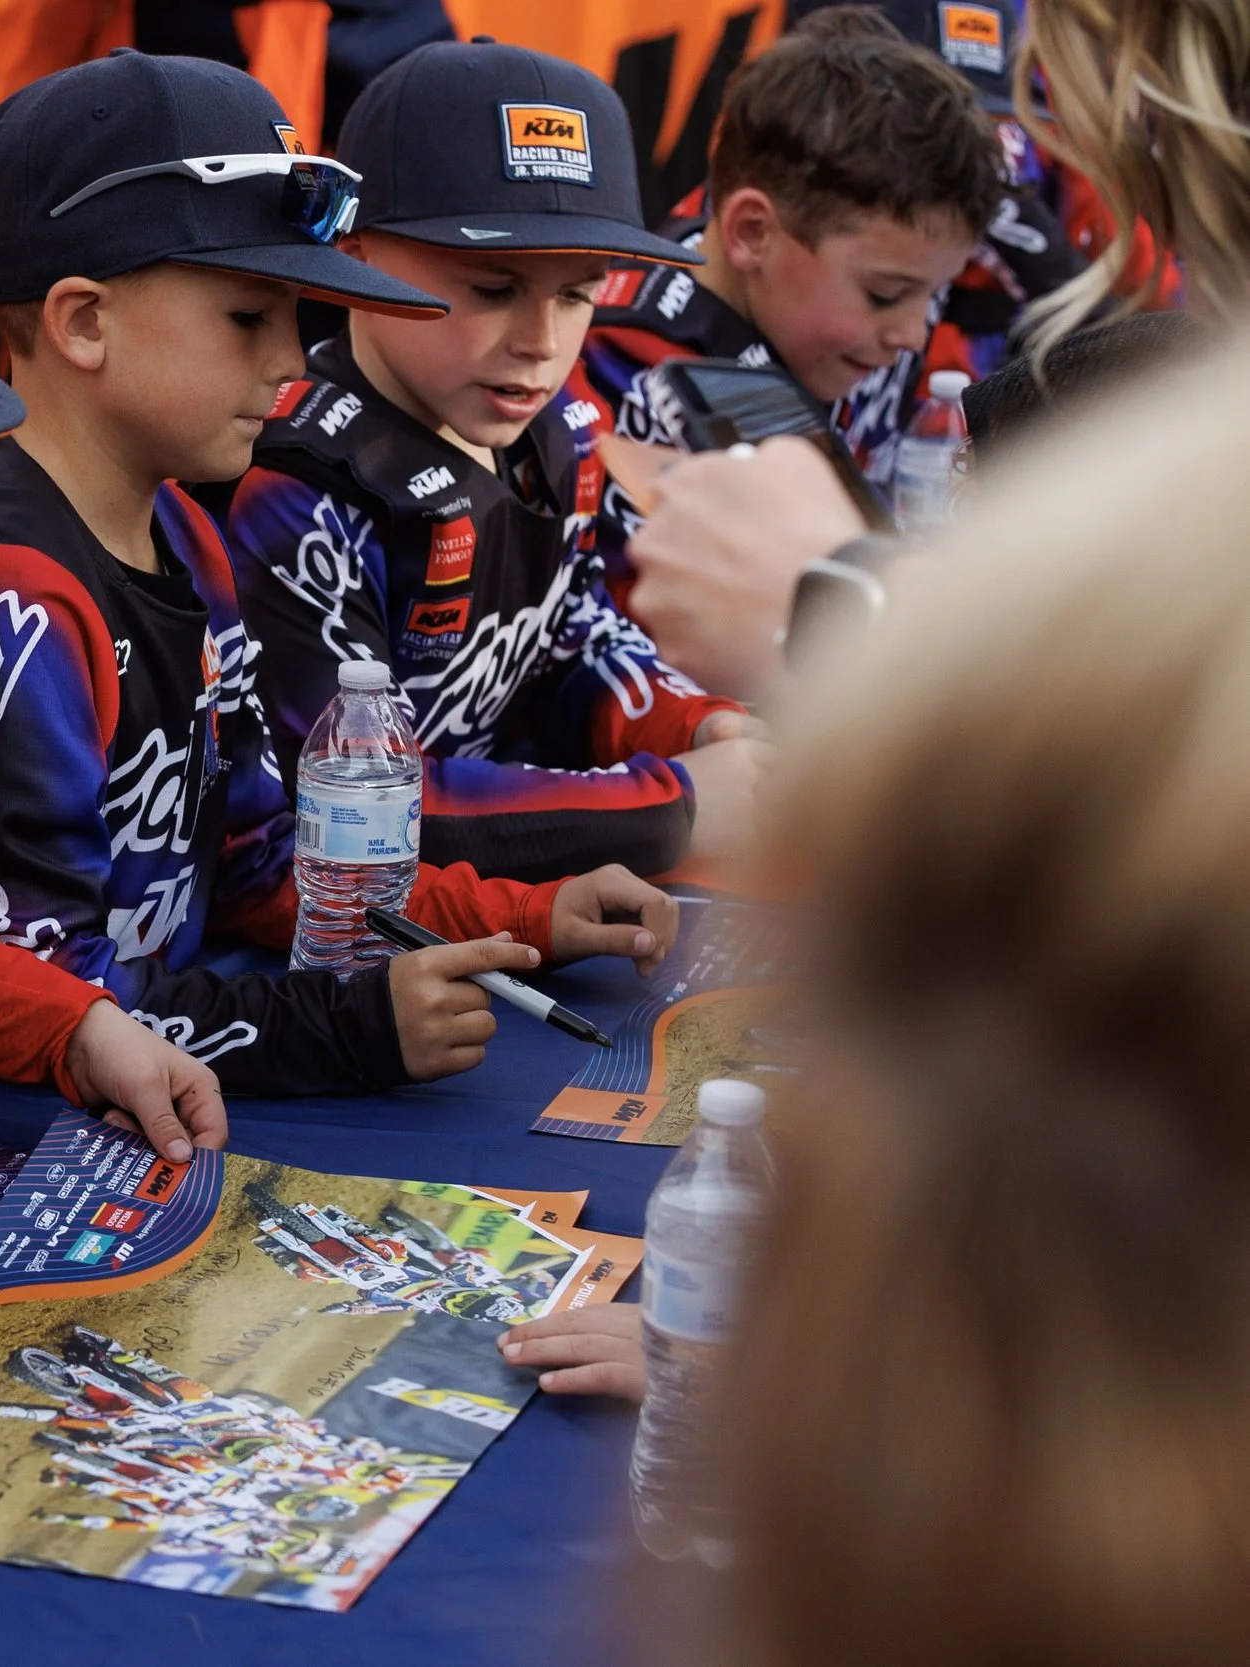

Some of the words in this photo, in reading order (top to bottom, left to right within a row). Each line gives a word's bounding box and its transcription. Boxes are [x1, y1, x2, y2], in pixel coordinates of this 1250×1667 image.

[523, 117, 575, 139] KTM
[512, 147, 558, 161] RACING
[559, 149, 587, 165] TEAM
[514, 165, 530, 178] JR.
[532, 165, 590, 182] SUPERCROSS
[657, 270, 696, 321] KTM
[318, 392, 363, 437] KTM
[562, 400, 601, 431] KTM
[407, 466, 456, 500] KTM
[436, 534, 472, 551] WELLS
[435, 549, 471, 565] FARGO
[612, 1098, 648, 1122] KTM
[81, 1135, 105, 1166] nihilo
[105, 1155, 134, 1191] SUPERCROSS
[132, 1151, 157, 1181] RACING
[58, 1175, 79, 1199] OGIO
[120, 1178, 138, 1197] TEAM
[147, 1164, 175, 1198] KTM
[37, 1211, 57, 1229] 100%
[65, 1191, 91, 1225] DUNLOP
[105, 1207, 124, 1227] FARGO
[115, 1210, 134, 1229] WELLS
[141, 1210, 164, 1234] Presented
[135, 1230, 146, 1241] by
[588, 1258, 615, 1282] KTM
[568, 1280, 597, 1311] POWE
